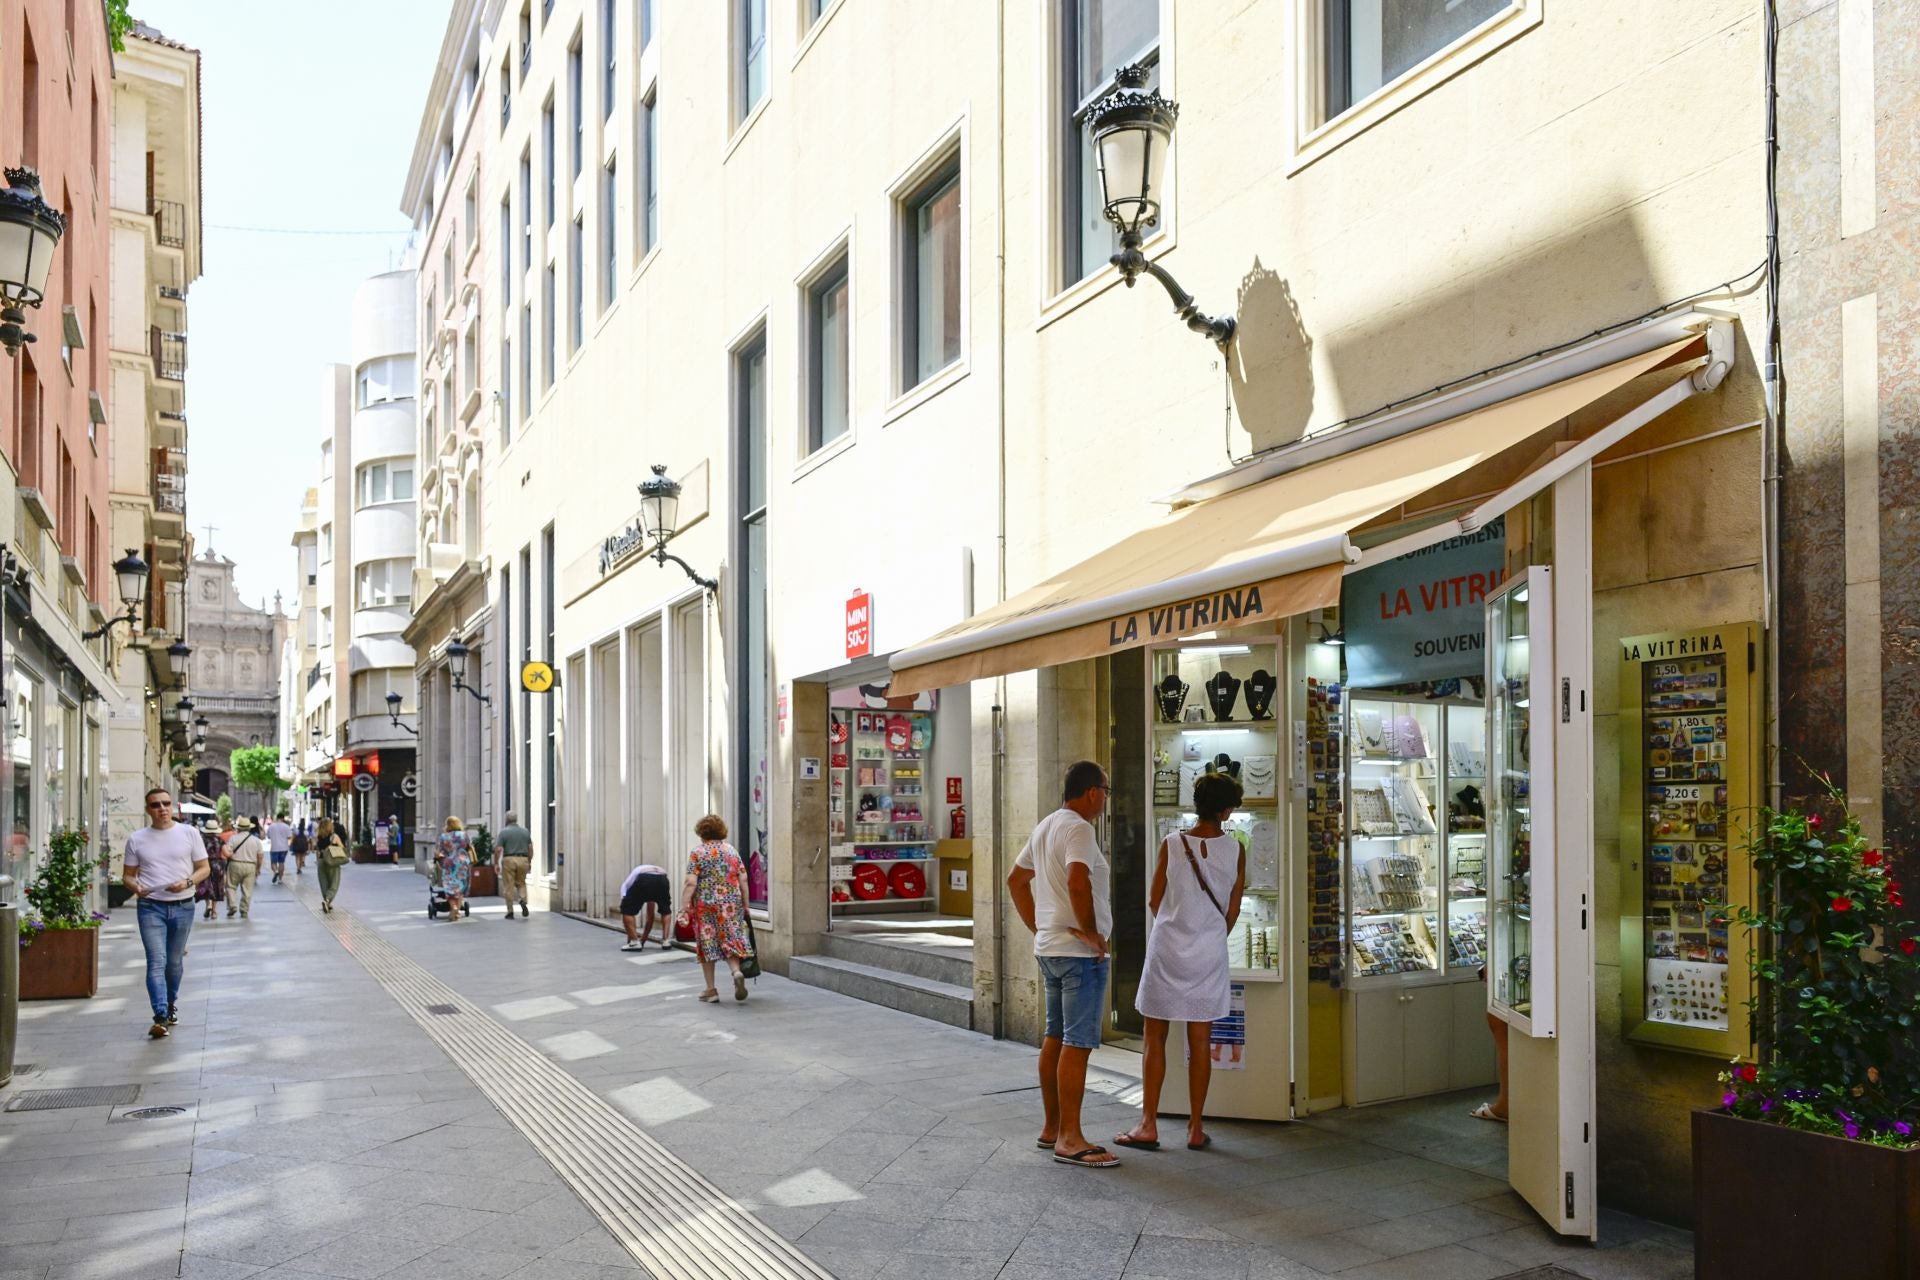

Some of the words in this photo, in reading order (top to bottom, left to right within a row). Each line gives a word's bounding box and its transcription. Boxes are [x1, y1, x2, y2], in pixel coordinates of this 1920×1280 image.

[1381, 587, 1412, 619] LA
[848, 606, 867, 627] MINI
[1110, 616, 1138, 646] LA
[1149, 586, 1263, 636] VITRINA
[1624, 645, 1640, 661] LA
[1656, 664, 1678, 676] 1,50
[1679, 717, 1699, 728] 1,80
[1665, 788, 1688, 799] 2,20
[1691, 788, 1699, 798] €
